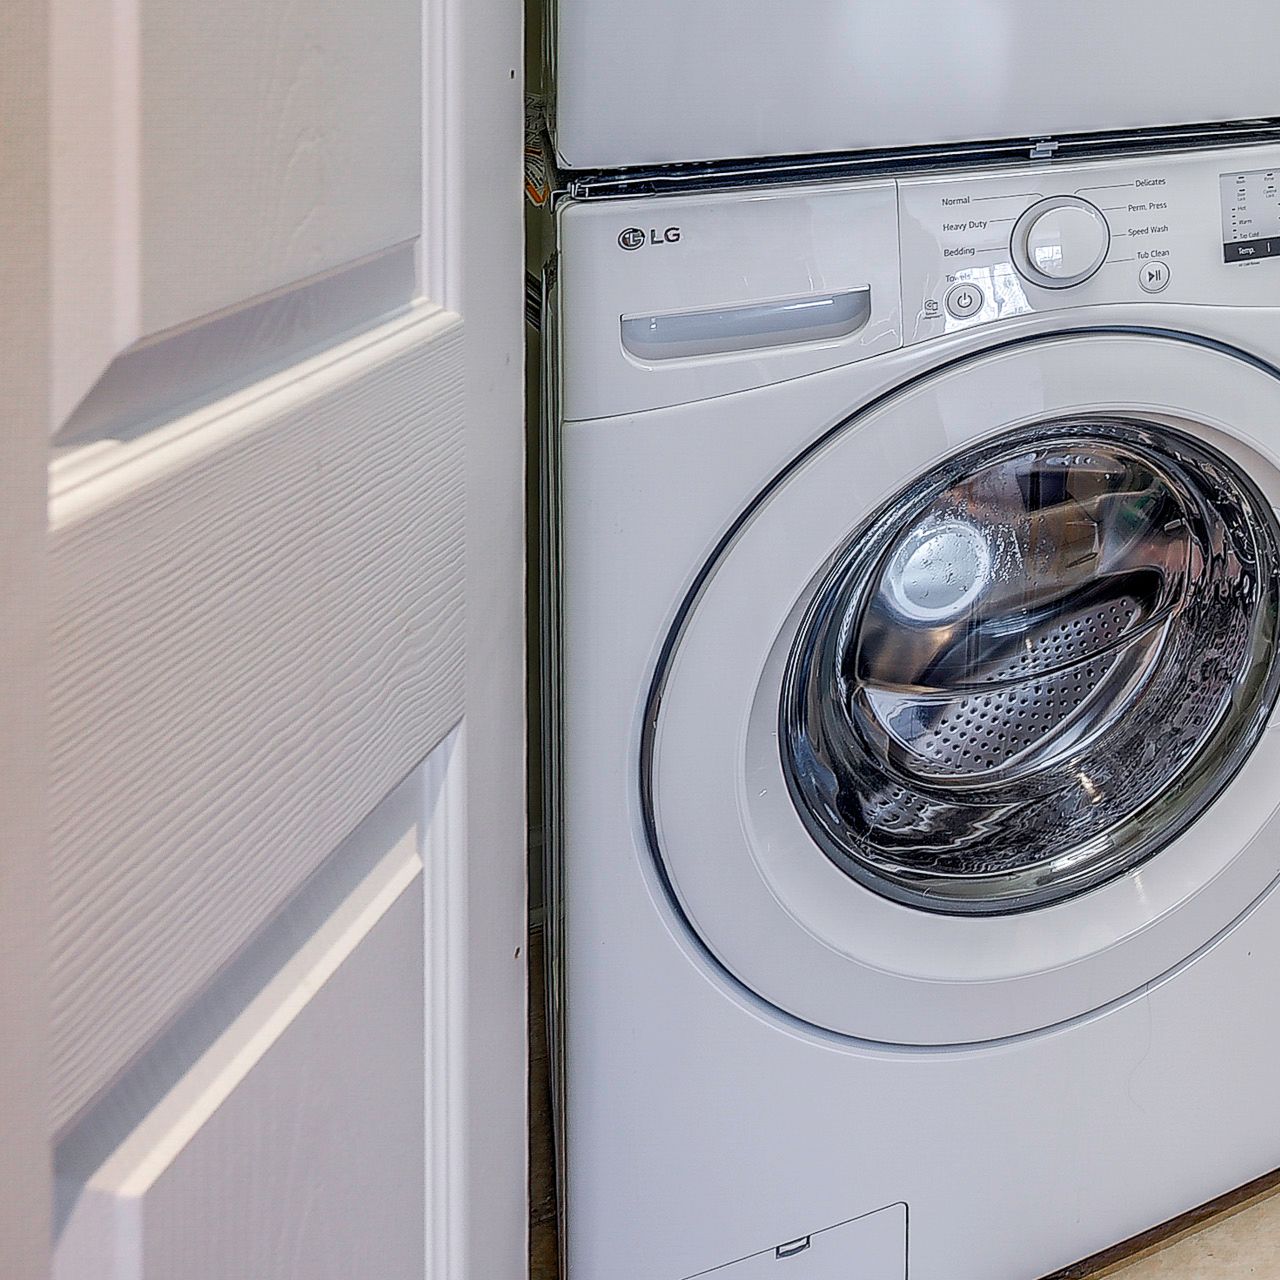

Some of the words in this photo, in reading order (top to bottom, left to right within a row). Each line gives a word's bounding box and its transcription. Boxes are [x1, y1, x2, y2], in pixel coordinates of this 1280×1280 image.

[1135, 178, 1167, 188] Delicates
[942, 196, 971, 207] Normal
[1127, 203, 1147, 212] Perm.
[1148, 202, 1168, 210] Press
[942, 222, 967, 232] Heavy
[968, 220, 987, 230] Duty
[1127, 227, 1149, 238] Speed
[1150, 224, 1169, 234] Wash
[650, 226, 680, 245] LG
[943, 247, 976, 257] Bedding
[1137, 251, 1149, 260] Tub
[1150, 249, 1170, 258] Clean
[1238, 246, 1255, 255] Temp.
